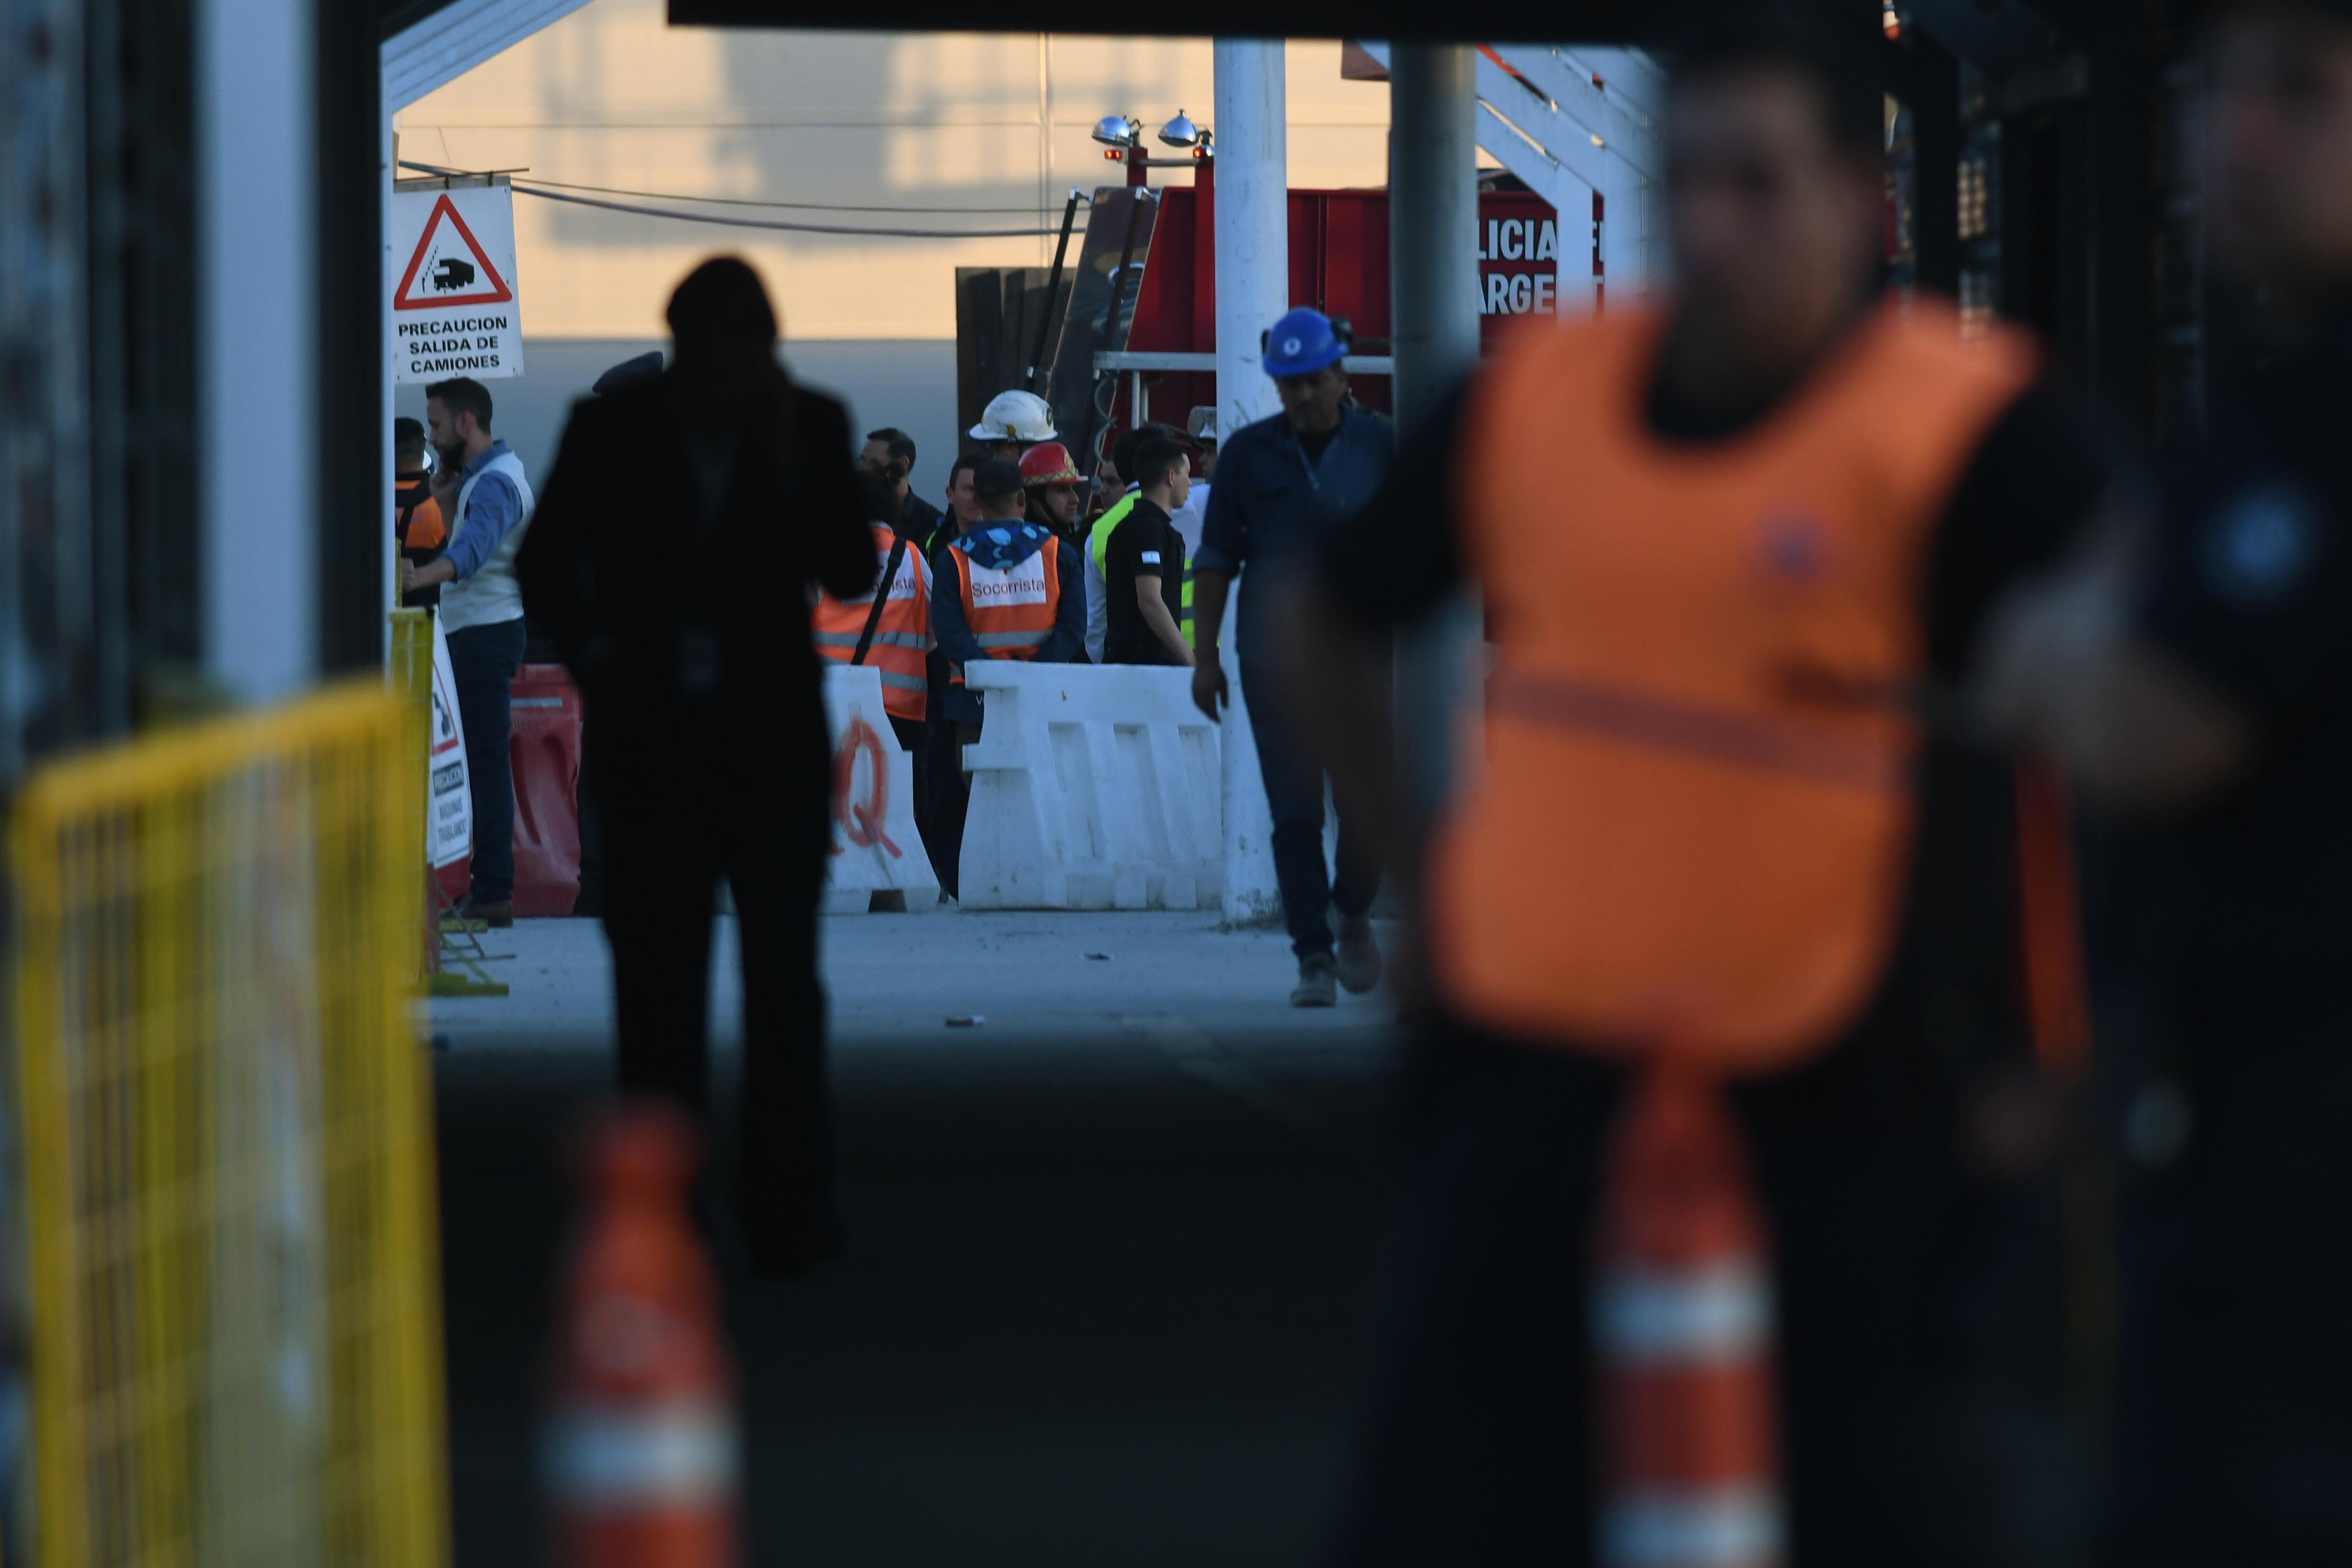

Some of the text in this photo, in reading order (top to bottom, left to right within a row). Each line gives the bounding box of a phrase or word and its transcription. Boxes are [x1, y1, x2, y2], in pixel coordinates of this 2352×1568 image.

[1477, 218, 1558, 261] LICIA
[398, 316, 507, 336] PRECAUCION
[410, 336, 498, 355] SALIDA DE
[411, 355, 500, 373] CAMIONES
[972, 578, 1044, 597] Socorrista
